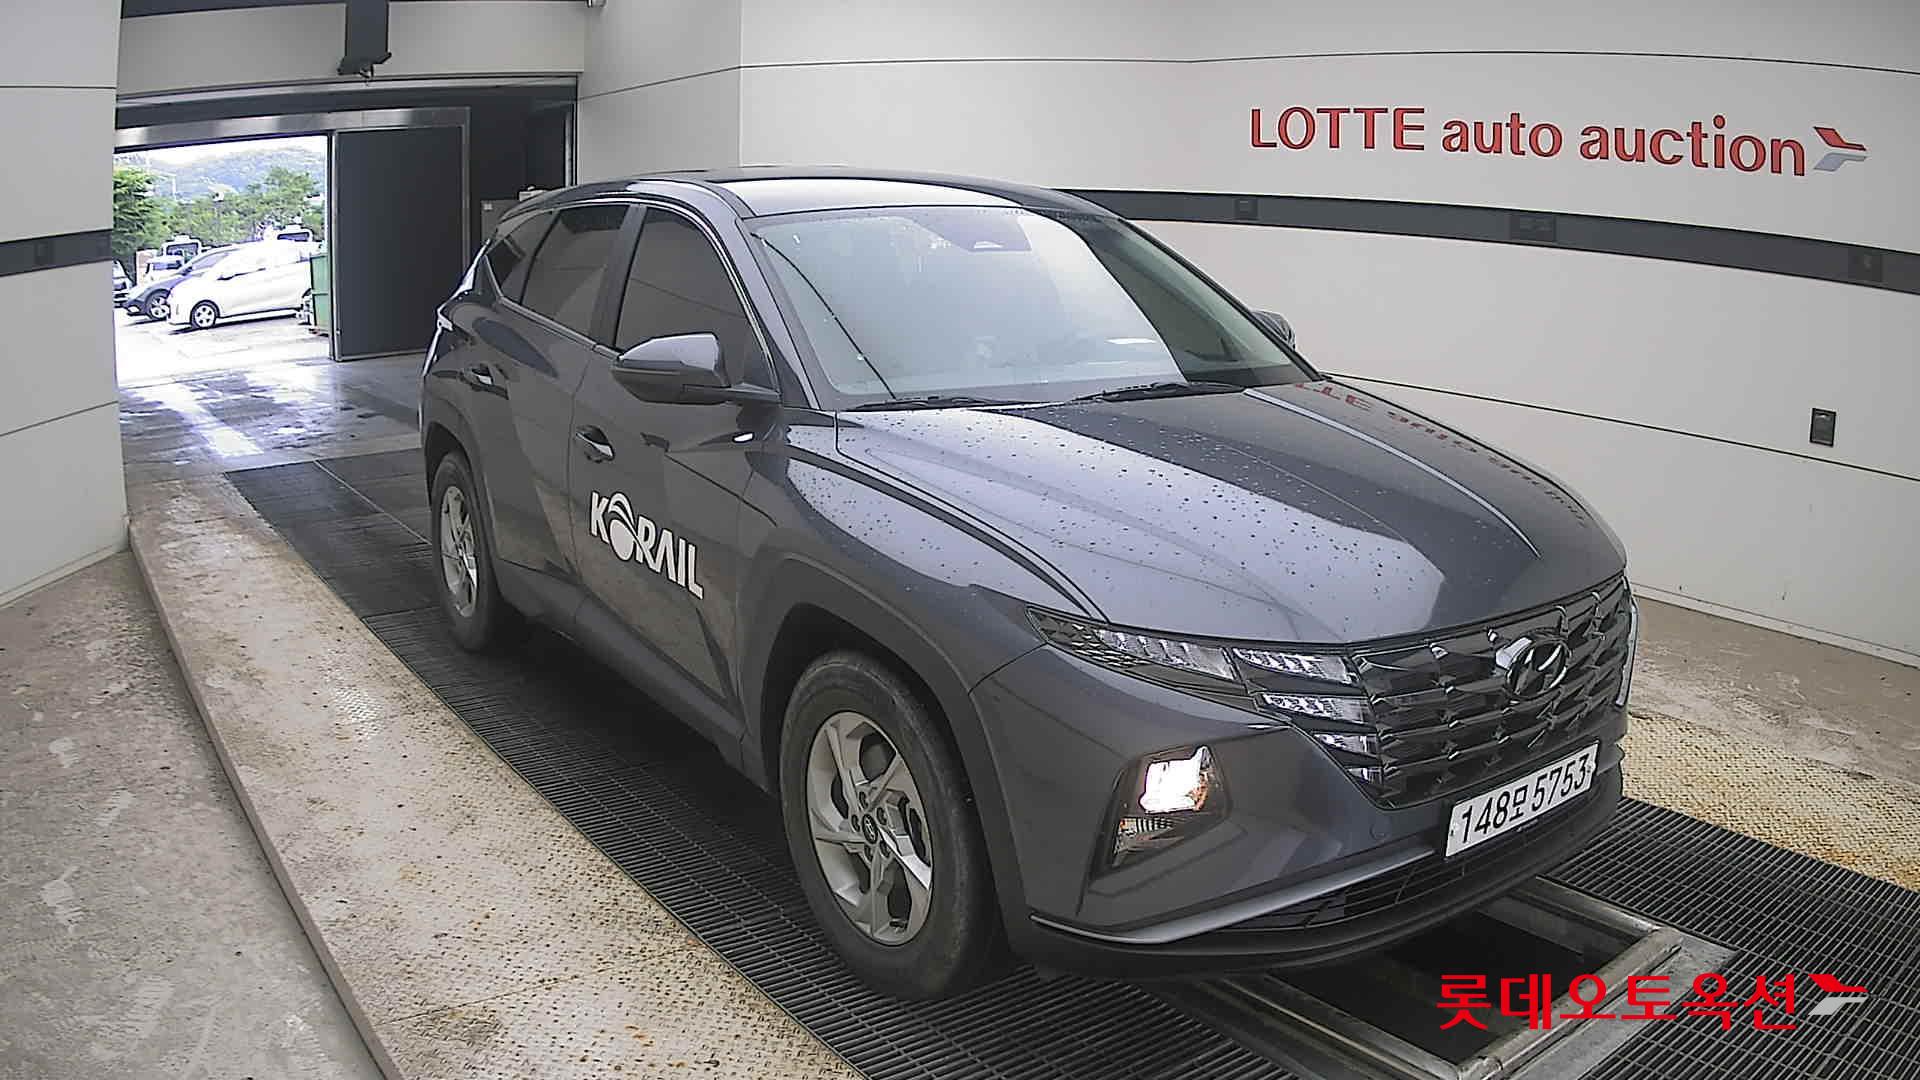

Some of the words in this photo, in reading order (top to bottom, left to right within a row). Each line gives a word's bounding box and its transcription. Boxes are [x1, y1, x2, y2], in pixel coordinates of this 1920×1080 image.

[1251, 107, 1425, 151] LOTTE
[1442, 112, 1563, 158] auto
[1579, 115, 1806, 176] auction
[590, 490, 704, 600] KORAIL
